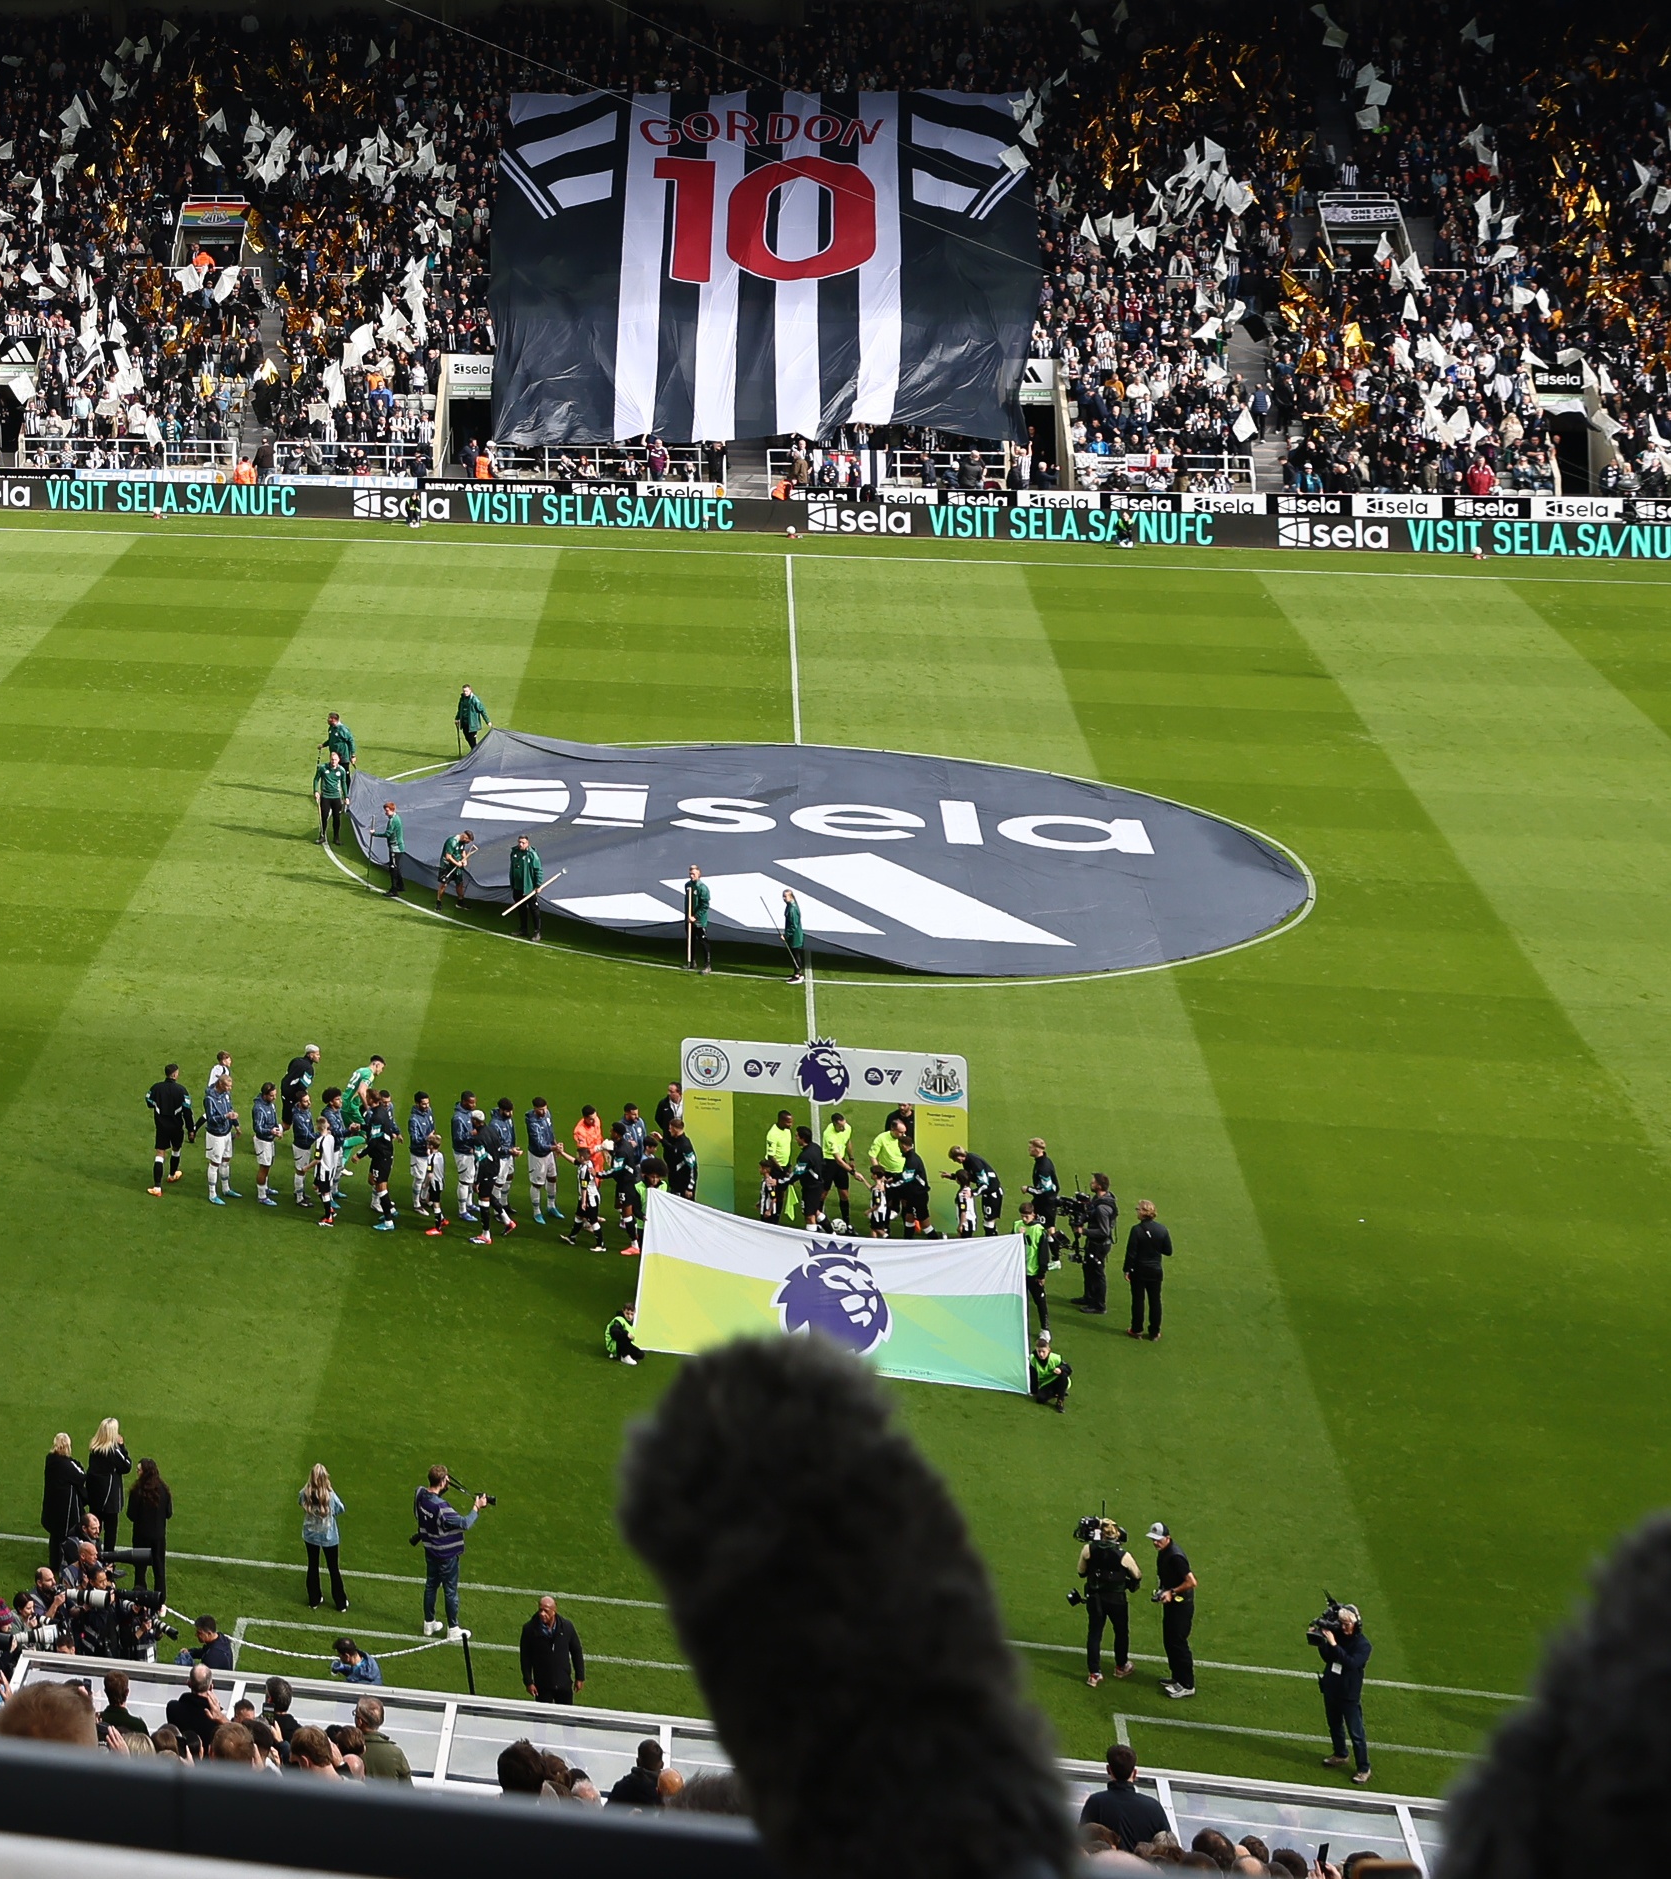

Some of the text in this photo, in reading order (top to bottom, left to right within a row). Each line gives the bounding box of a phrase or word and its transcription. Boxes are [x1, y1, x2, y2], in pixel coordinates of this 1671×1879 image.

[639, 110, 884, 147] GORDON
[653, 154, 877, 283] 10
[465, 364, 490, 375] sela
[1549, 373, 1581, 386] sela
[45, 479, 297, 517] VISIT SELA.SA/NUFC
[887, 490, 927, 504] sela
[966, 491, 1008, 507] sela
[1048, 493, 1089, 509] sela
[1128, 495, 1172, 512] sela
[1213, 497, 1254, 514] sela
[1296, 497, 1341, 514] sela
[466, 492, 733, 531] VISIT SELA.SA/NUFC
[1386, 499, 1428, 515] sela
[1474, 499, 1519, 517] sela
[1565, 501, 1608, 518] sela
[840, 505, 912, 535] sela
[929, 505, 1000, 538] VISIT
[1312, 519, 1389, 549] sela
[1406, 520, 1483, 554] VISIT
[670, 797, 1155, 856] sela
[690, 1047, 725, 1062] MANCHESTER
